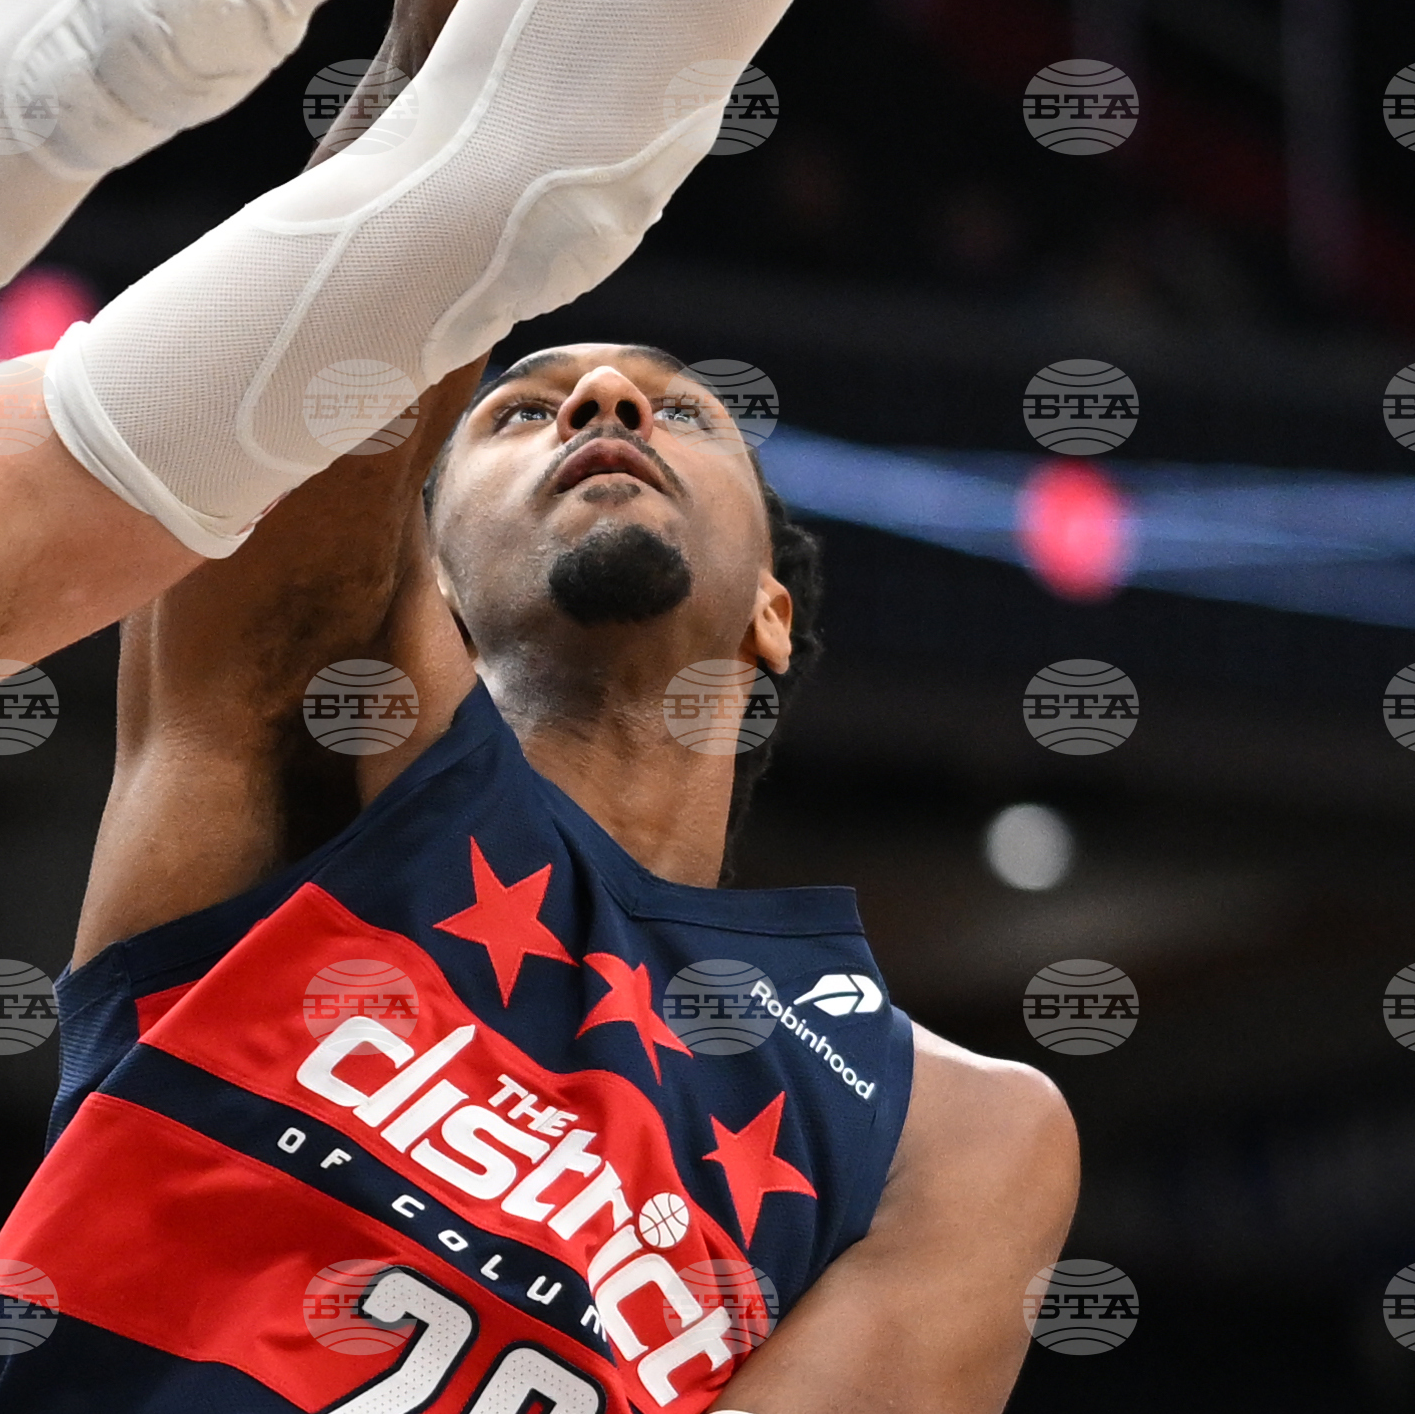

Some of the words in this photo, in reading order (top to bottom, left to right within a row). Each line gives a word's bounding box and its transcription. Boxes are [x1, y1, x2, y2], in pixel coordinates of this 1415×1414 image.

[750, 980, 875, 1100] Robinhood
[487, 1073, 578, 1137] THE
[276, 1126, 353, 1169] OF
